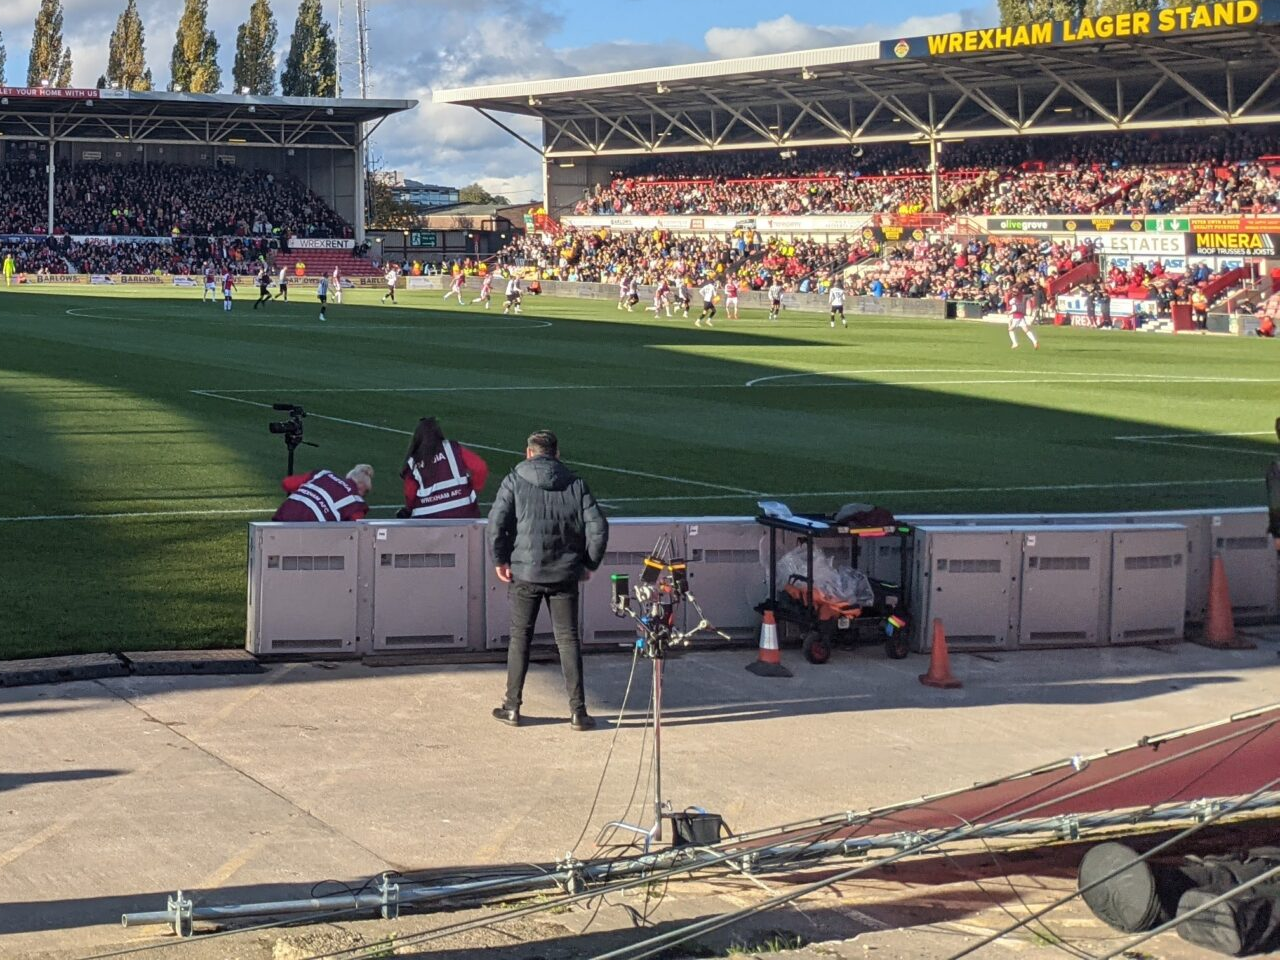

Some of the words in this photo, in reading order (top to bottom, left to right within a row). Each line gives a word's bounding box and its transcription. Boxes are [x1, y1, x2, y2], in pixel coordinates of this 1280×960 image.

[927, 23, 1052, 55] WREXHAM
[1062, 11, 1150, 42] LAGER
[1158, 0, 1259, 32] STAND
[15, 88, 37, 96] YOUR
[39, 89, 62, 97] HOME
[1000, 220, 1048, 230] olivegrove
[300, 239, 349, 249] WREXRENT
[1111, 237, 1180, 251] ESTATES
[1196, 233, 1264, 248] MINERA
[1197, 247, 1216, 255] ROOF
[1252, 248, 1275, 256] JOISTS
[421, 492, 451, 505] WREXHAM
[451, 488, 463, 498] AFC
[319, 500, 331, 514] AFC
